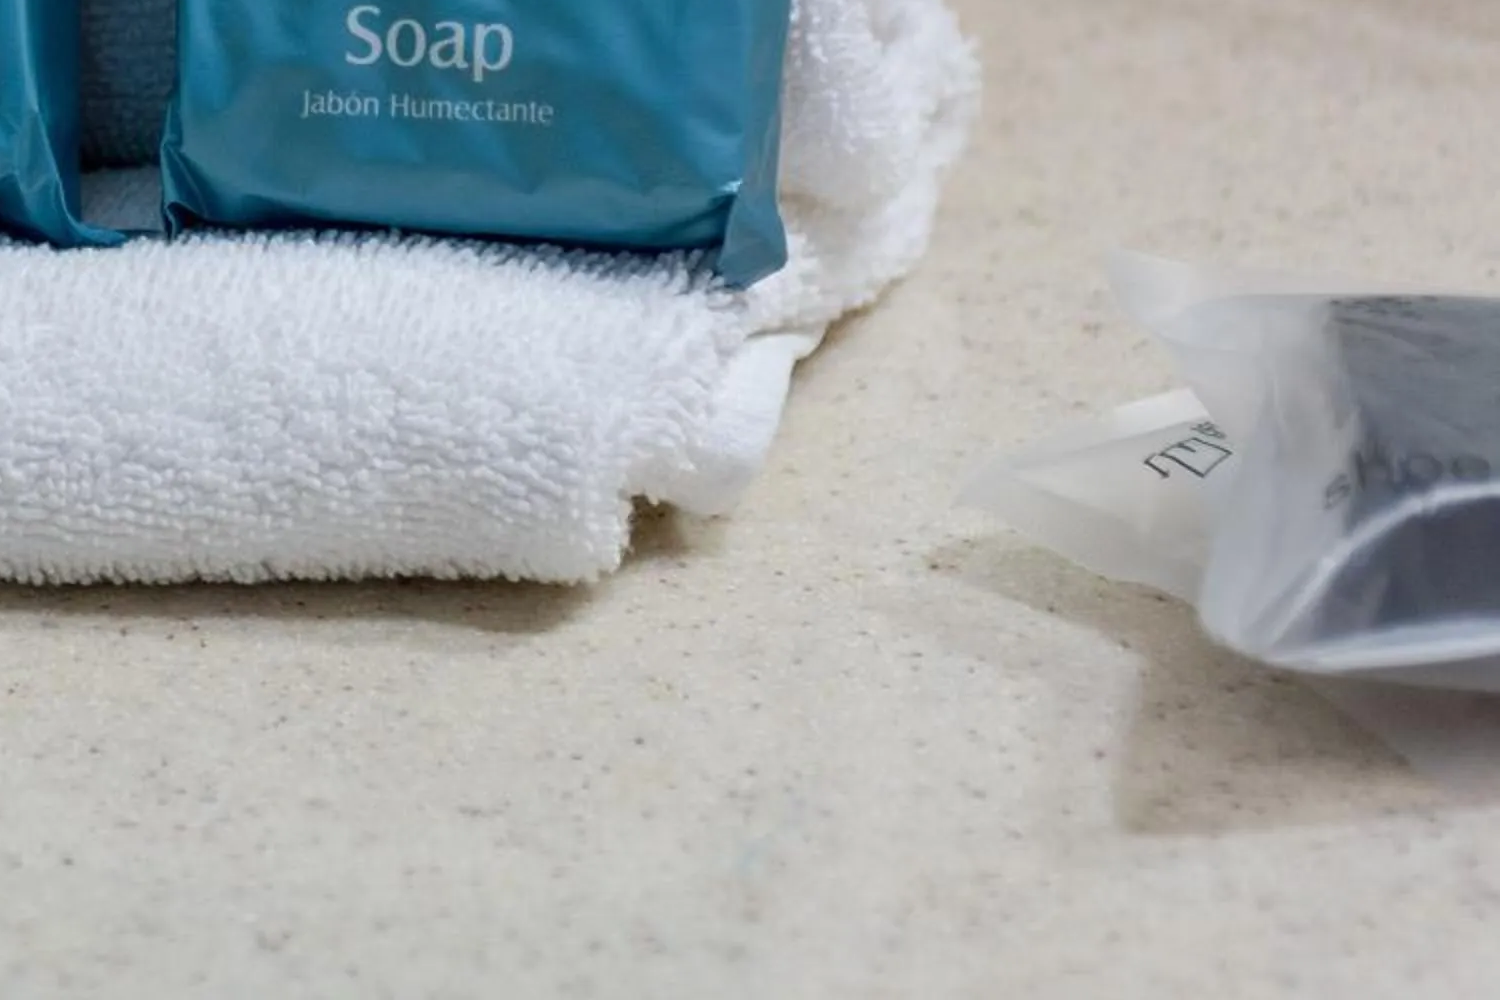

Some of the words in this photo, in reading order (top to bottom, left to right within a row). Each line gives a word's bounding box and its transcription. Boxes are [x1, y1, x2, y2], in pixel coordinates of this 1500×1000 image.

[345, 4, 514, 83] Soap
[301, 89, 380, 119] Jabón
[390, 92, 555, 124] Humectante
